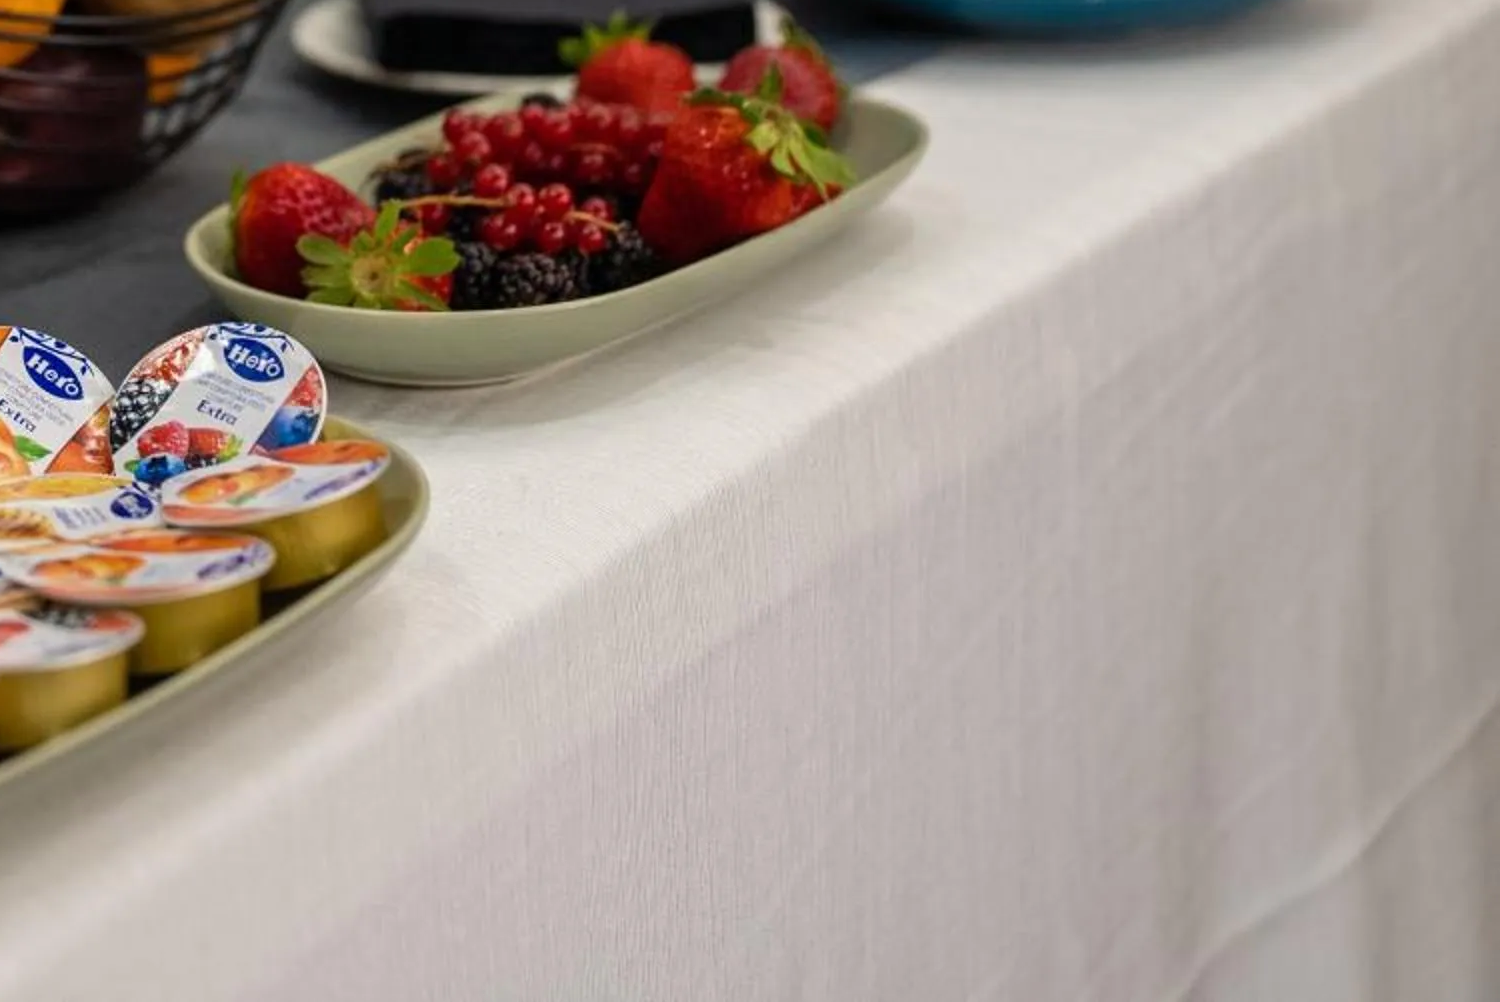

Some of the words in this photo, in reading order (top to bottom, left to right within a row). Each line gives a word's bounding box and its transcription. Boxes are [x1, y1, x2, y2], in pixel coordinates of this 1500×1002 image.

[27, 351, 80, 398] Hero
[227, 339, 282, 379] Hero
[197, 399, 238, 427] Extra
